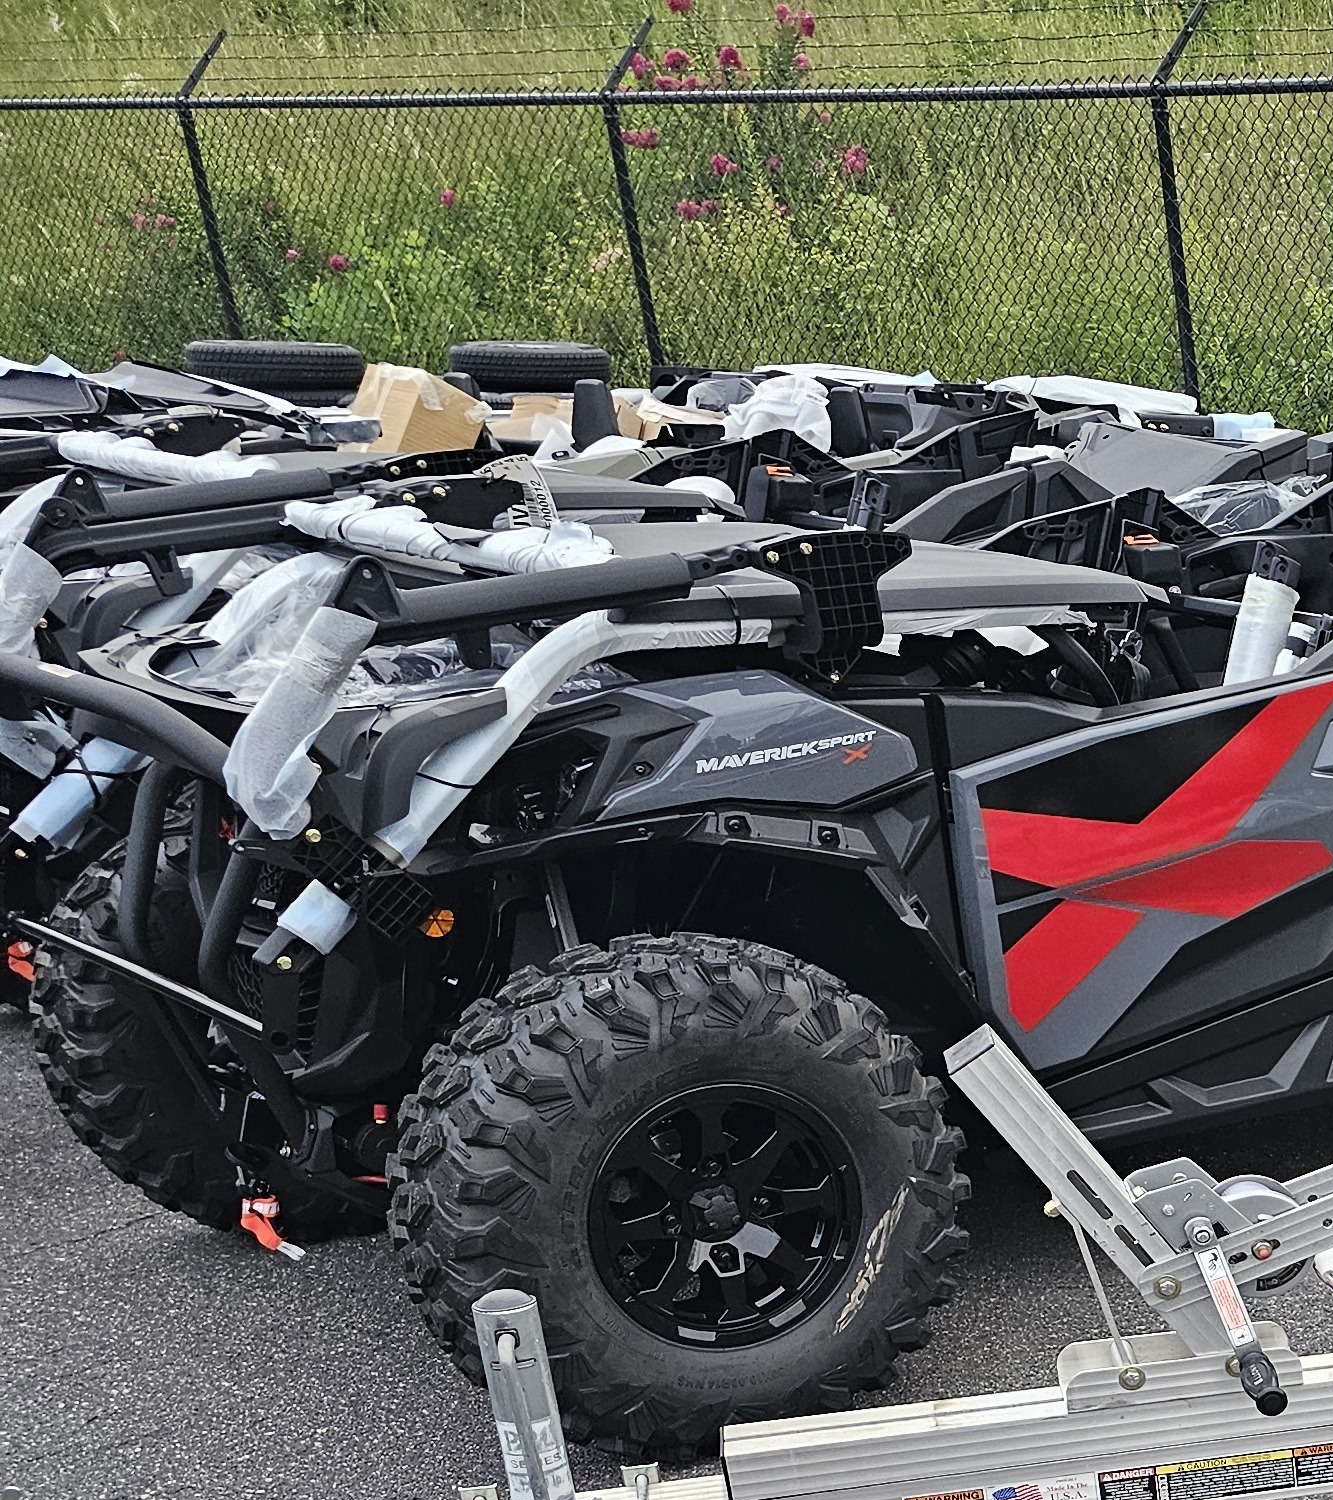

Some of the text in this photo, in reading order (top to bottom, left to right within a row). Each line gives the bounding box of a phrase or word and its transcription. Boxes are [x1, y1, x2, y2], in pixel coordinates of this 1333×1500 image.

[695, 730, 877, 774] MAVERICK SPORT
[842, 743, 873, 765] X
[510, 1452, 562, 1469] SEES
[1186, 1459, 1227, 1471] CAUTION
[1112, 1467, 1155, 1480] DANGER
